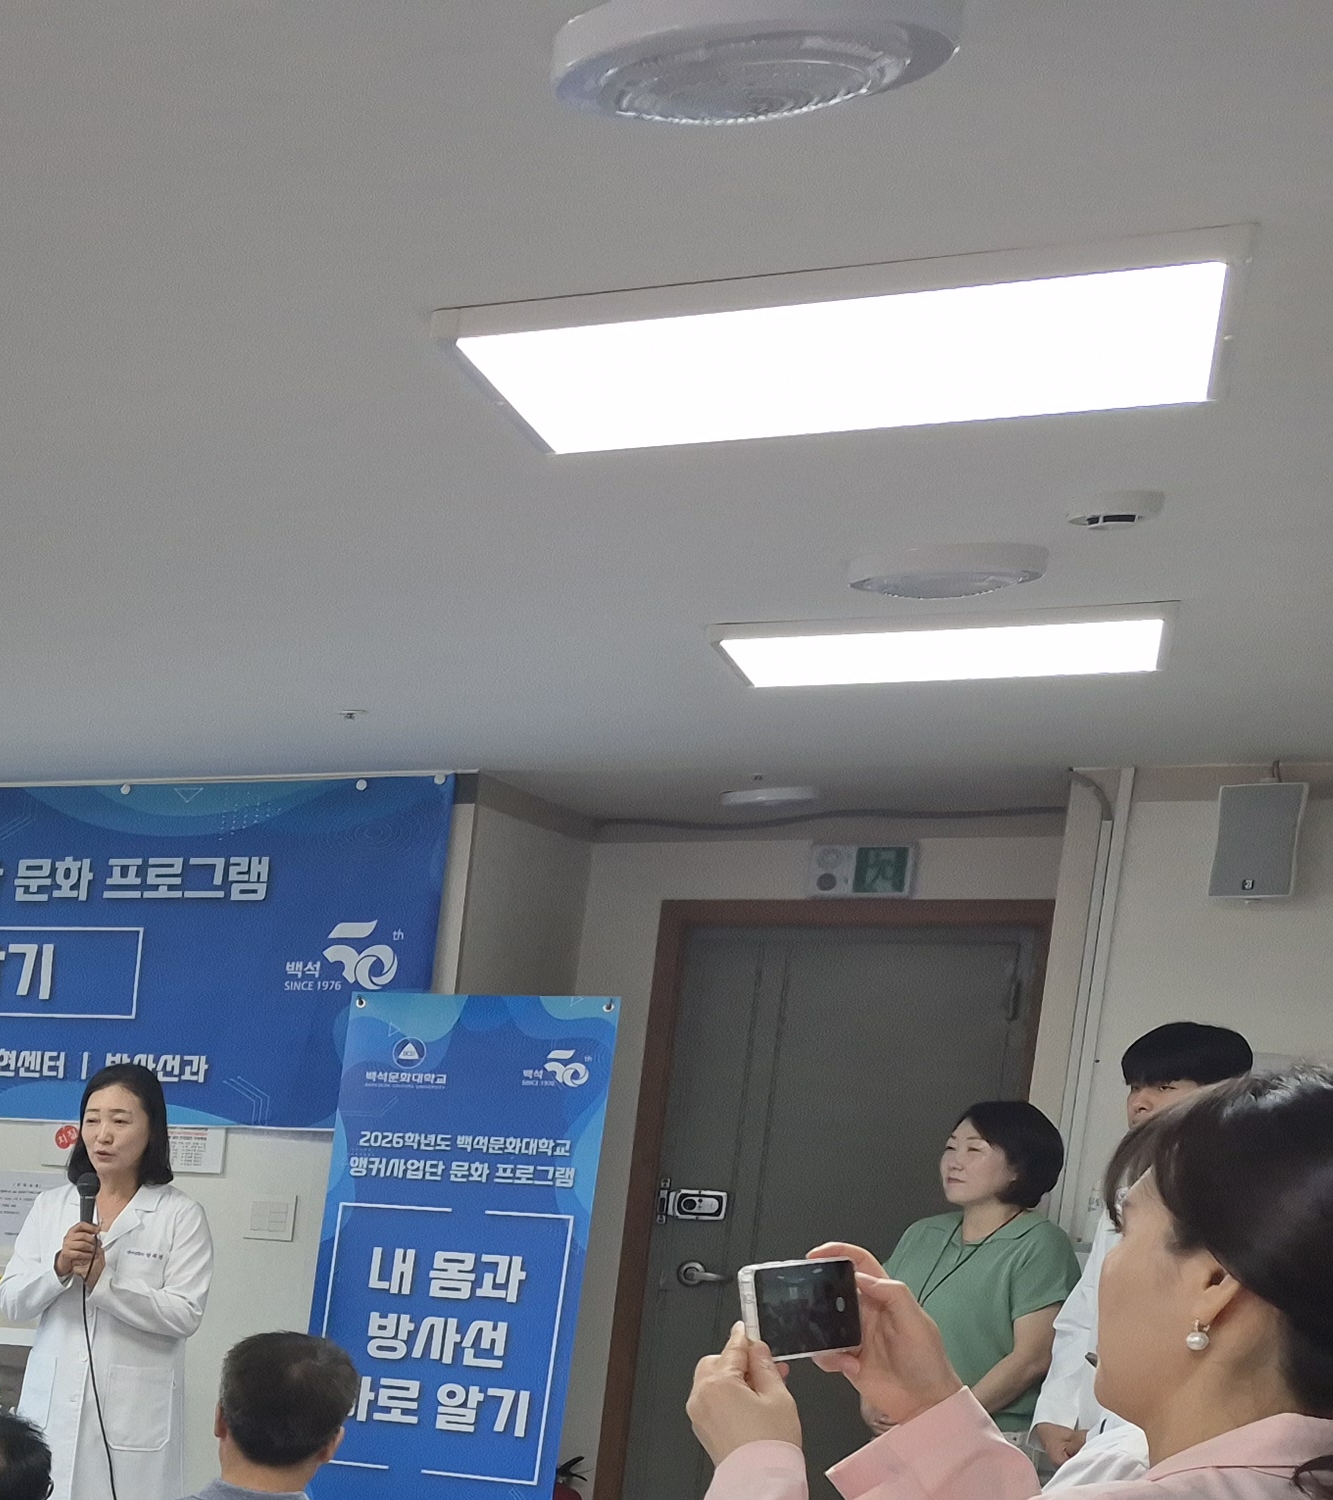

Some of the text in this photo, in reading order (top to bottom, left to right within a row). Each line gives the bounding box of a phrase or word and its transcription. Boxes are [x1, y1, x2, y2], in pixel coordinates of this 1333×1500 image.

[14, 856, 93, 901] 문화
[102, 857, 270, 901] 프로그램
[284, 981, 342, 991] SINCE 1976
[285, 961, 321, 978] 백석
[359, 1131, 571, 1156] 2026학년도 백석문화대학교
[349, 1156, 576, 1188] 앵커사업단 문화 프로그램
[368, 1246, 527, 1303] 내 몸과
[366, 1311, 509, 1369] 방사선
[435, 1382, 531, 1438] 알기
